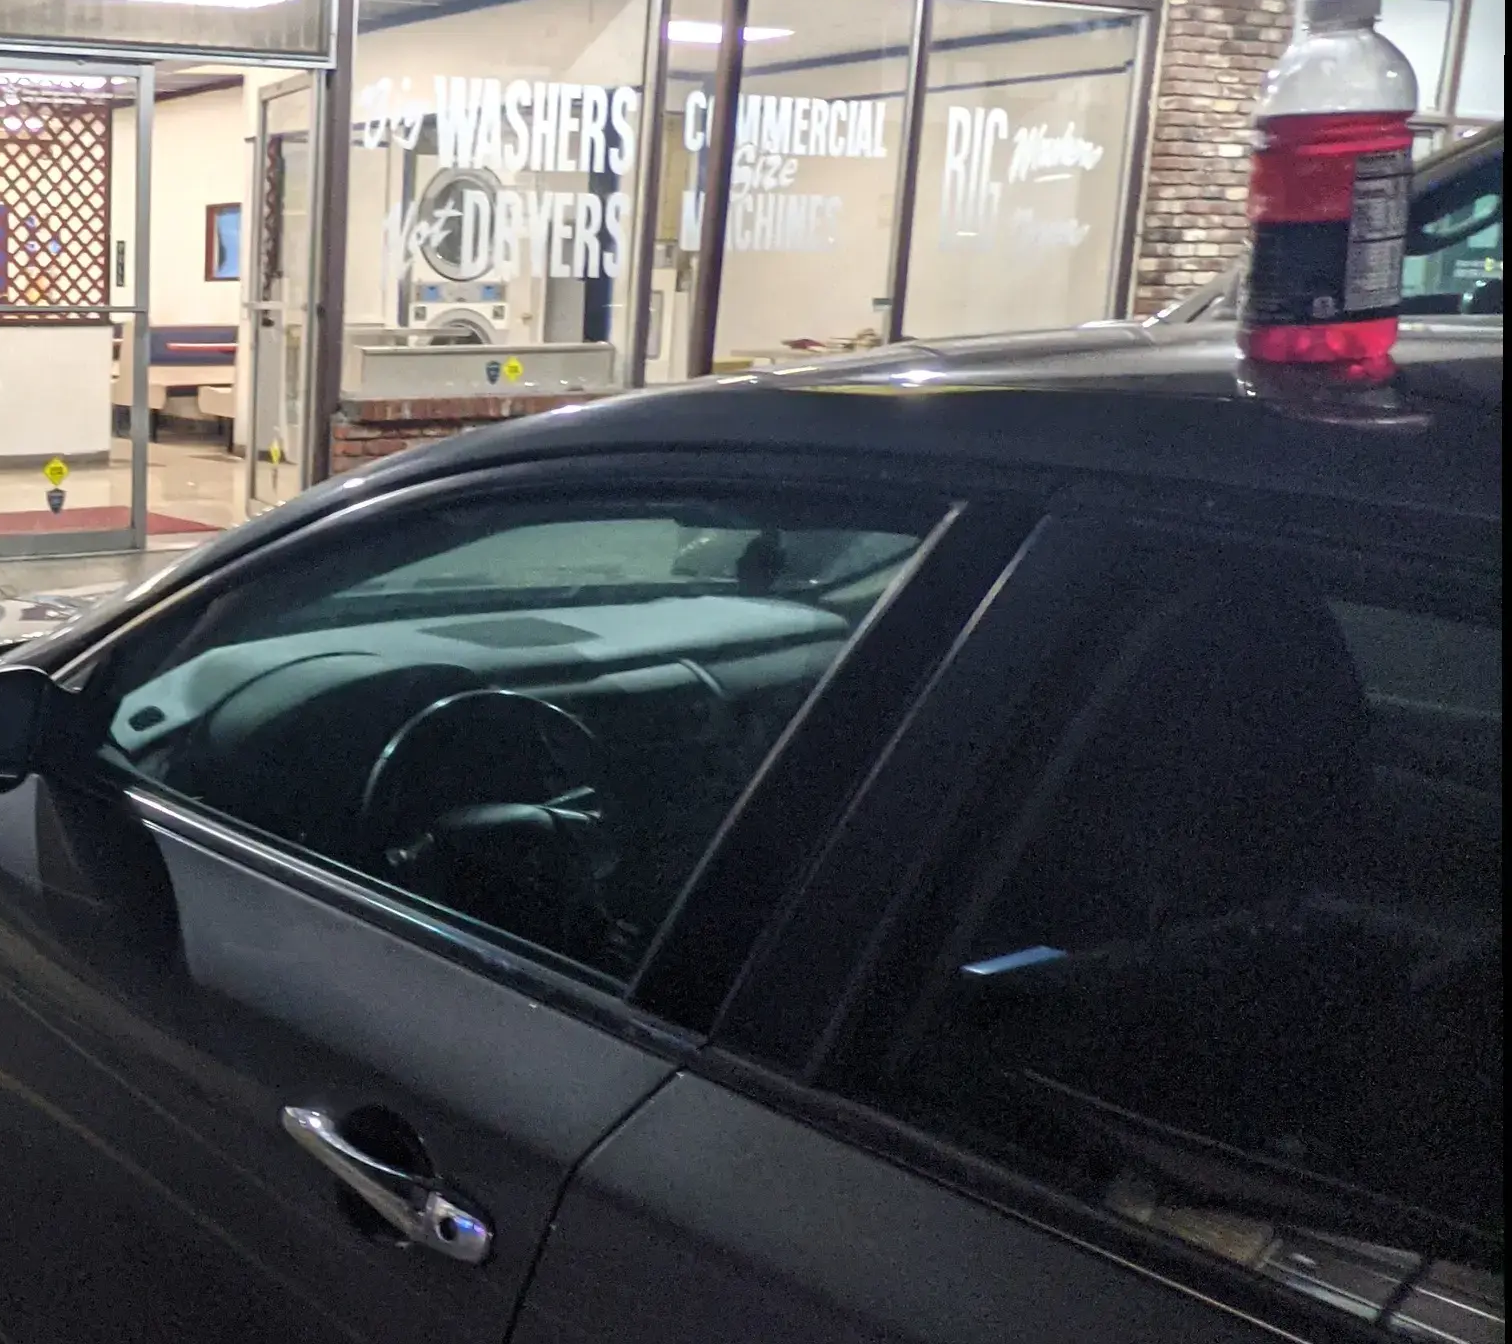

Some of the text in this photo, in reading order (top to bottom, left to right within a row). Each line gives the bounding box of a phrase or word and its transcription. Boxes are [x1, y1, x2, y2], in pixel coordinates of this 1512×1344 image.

[433, 75, 638, 176] WASHERS
[730, 142, 799, 202] Size
[459, 189, 631, 279] DRYERS
[680, 191, 842, 252] MCHINES
